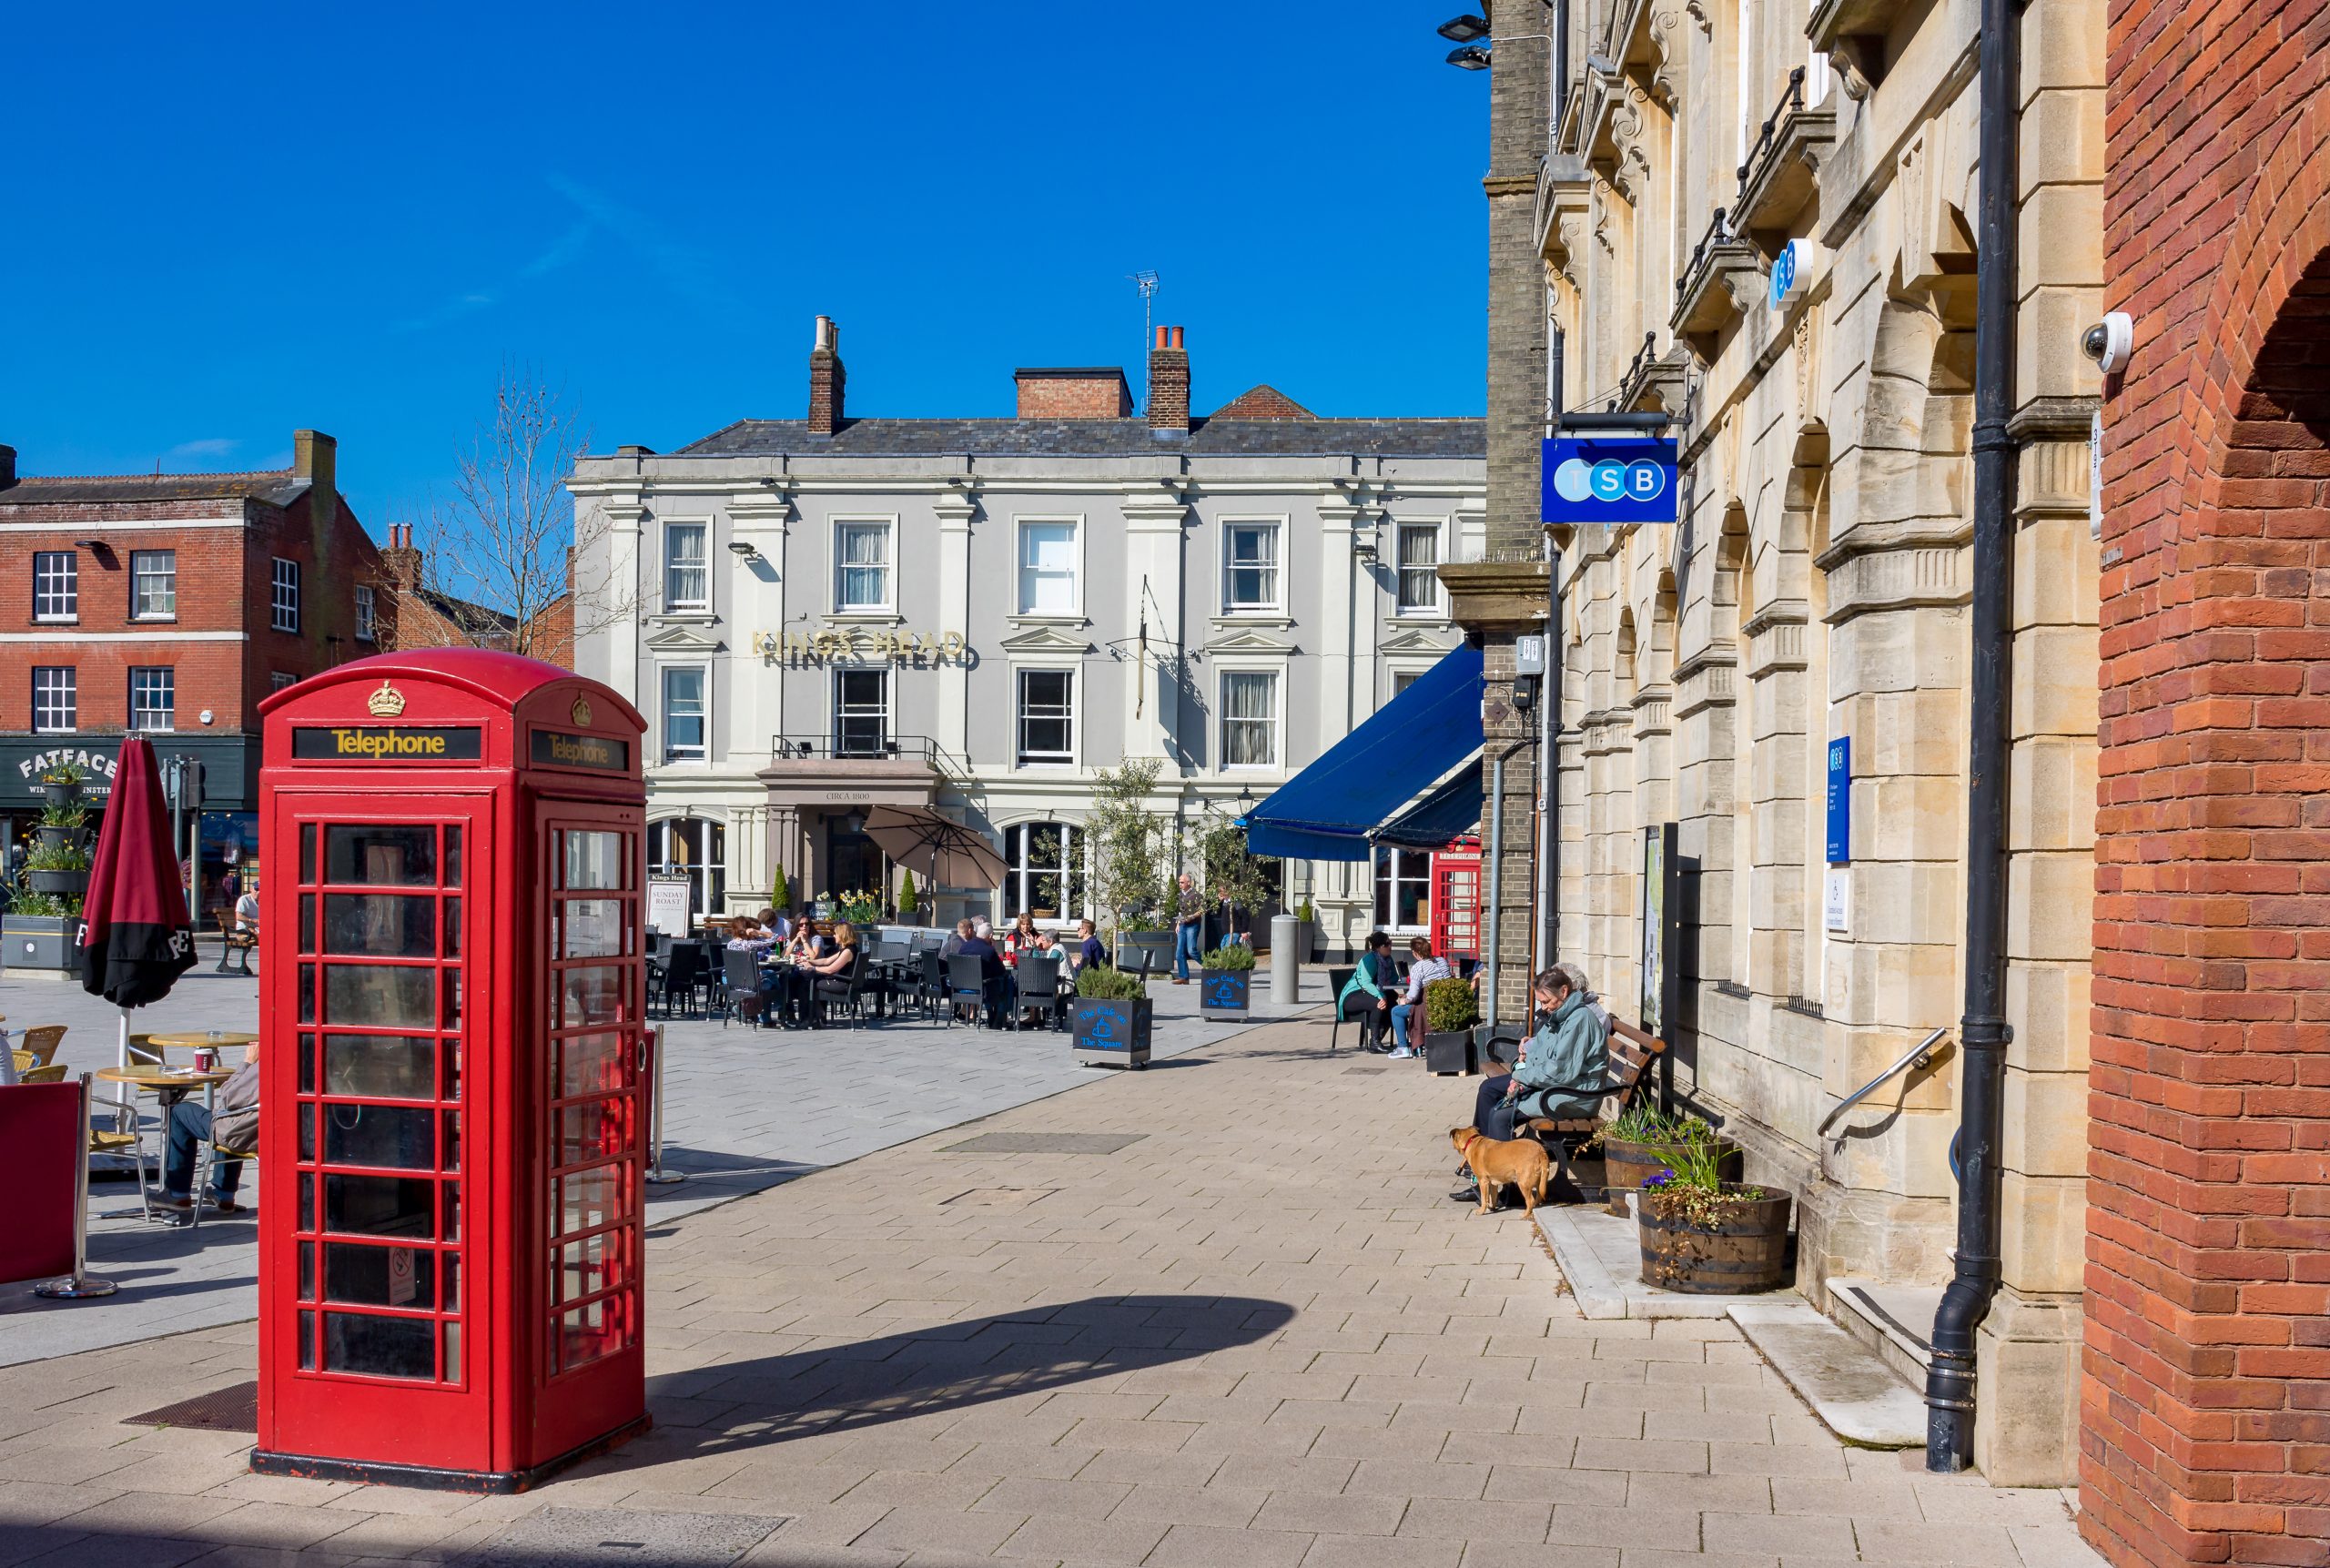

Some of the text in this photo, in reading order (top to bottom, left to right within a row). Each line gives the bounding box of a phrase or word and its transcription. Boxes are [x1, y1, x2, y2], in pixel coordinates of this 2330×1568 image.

[1569, 469, 1654, 491] TSB
[753, 631, 965, 655] KINGS HEAD
[331, 730, 445, 758] Telephone
[549, 734, 608, 764] Telephone
[19, 749, 117, 778] FATFACE
[653, 891, 684, 899] SUNDAY
[1079, 1009, 1095, 1020] The
[1117, 1014, 1128, 1026] on
[1080, 1037, 1096, 1047] The
[1098, 1038, 1122, 1049] Square
